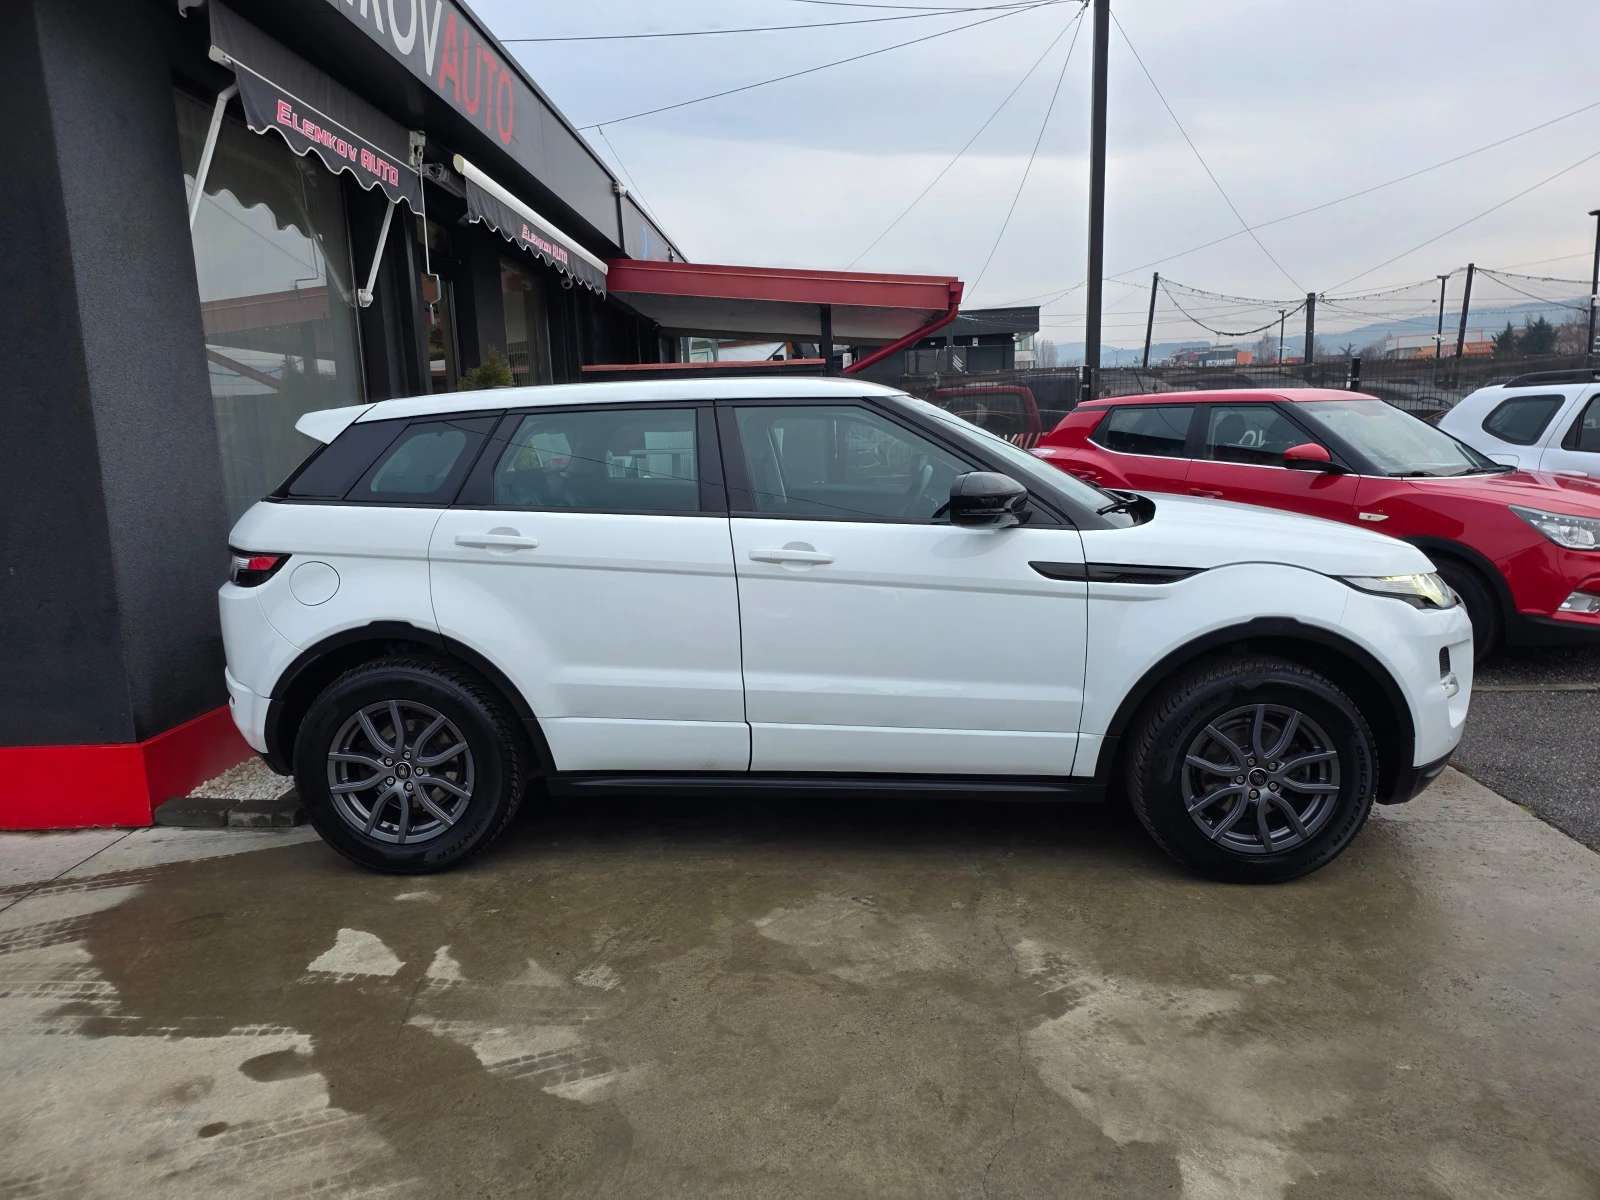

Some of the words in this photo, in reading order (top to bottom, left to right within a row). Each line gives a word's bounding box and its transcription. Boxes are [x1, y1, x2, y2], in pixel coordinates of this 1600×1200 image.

[277, 99, 358, 162] ELENKOV
[361, 148, 398, 187] AUTO
[552, 243, 567, 265] AUTO
[1168, 694, 1221, 748] COOPER
[1332, 745, 1368, 847] DISCOVERER
[436, 818, 486, 860] WINTER
